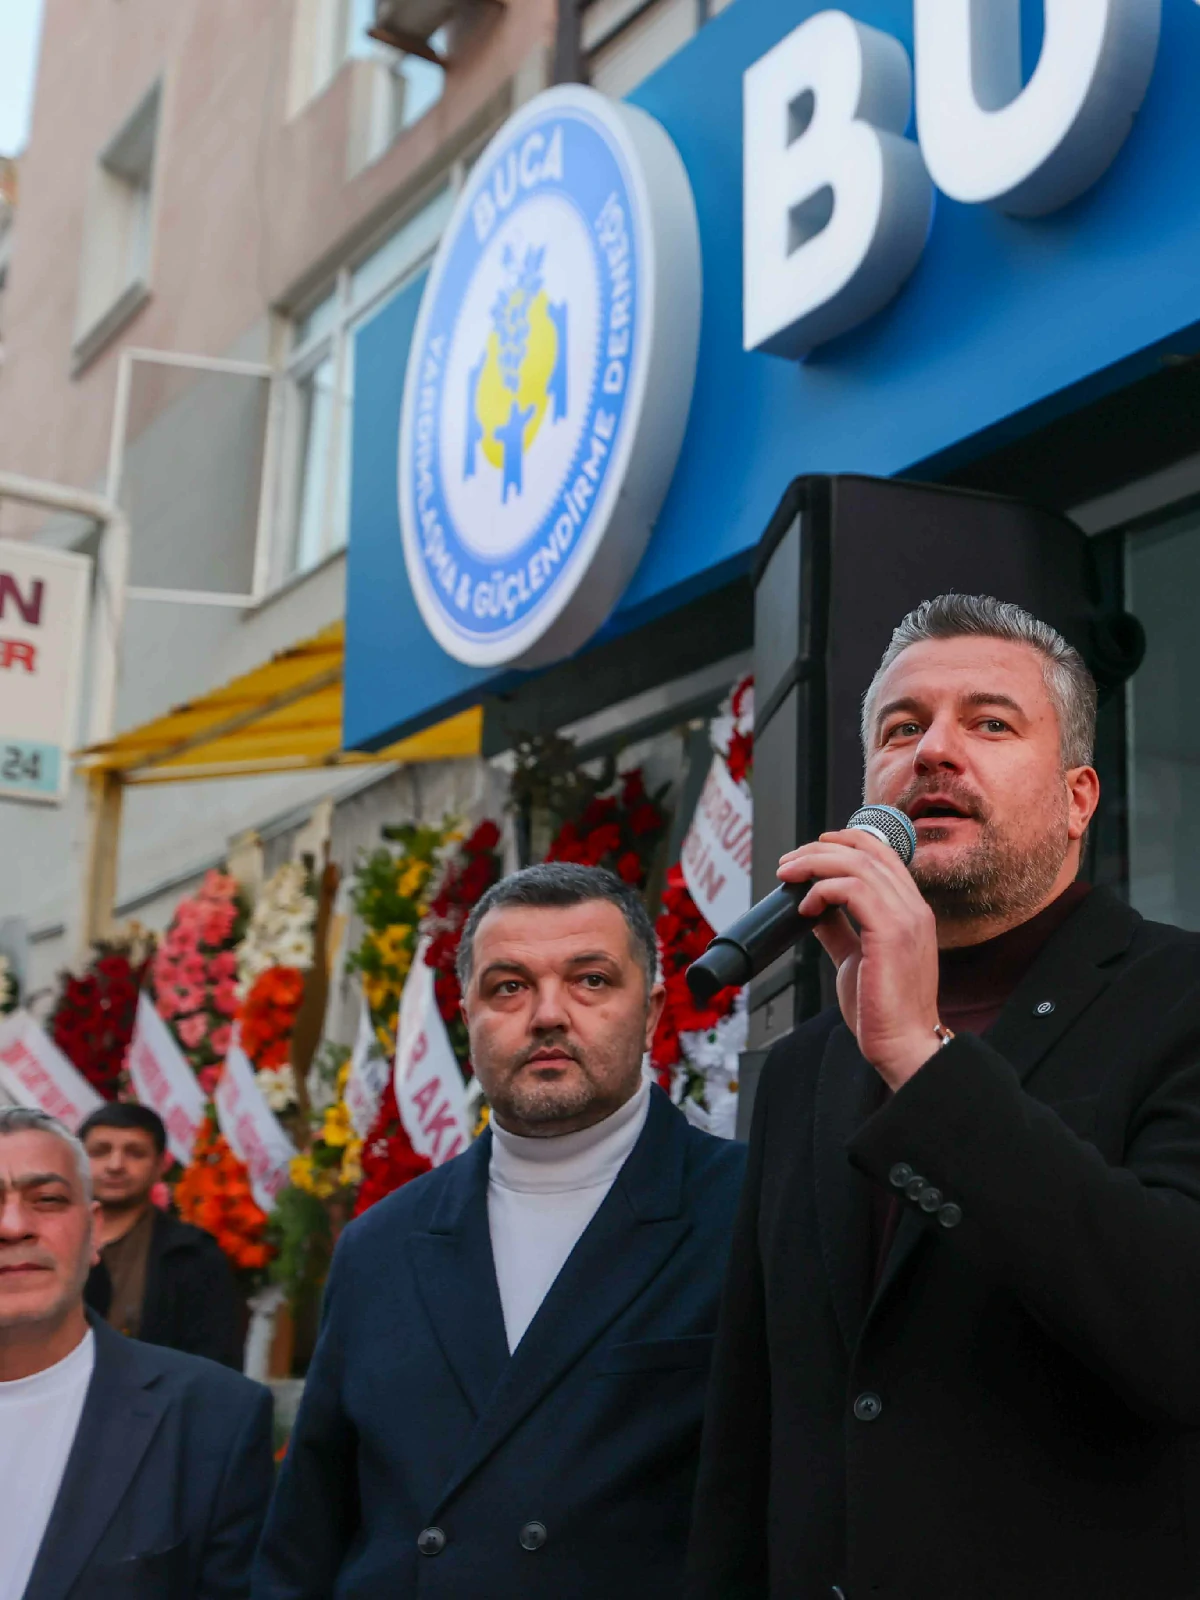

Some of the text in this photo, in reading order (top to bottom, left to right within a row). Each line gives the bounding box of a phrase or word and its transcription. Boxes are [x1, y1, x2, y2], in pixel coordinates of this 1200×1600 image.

[473, 124, 564, 243] BUCA
[472, 407, 617, 620] GÜÇLENDİRME
[0, 640, 35, 671] R
